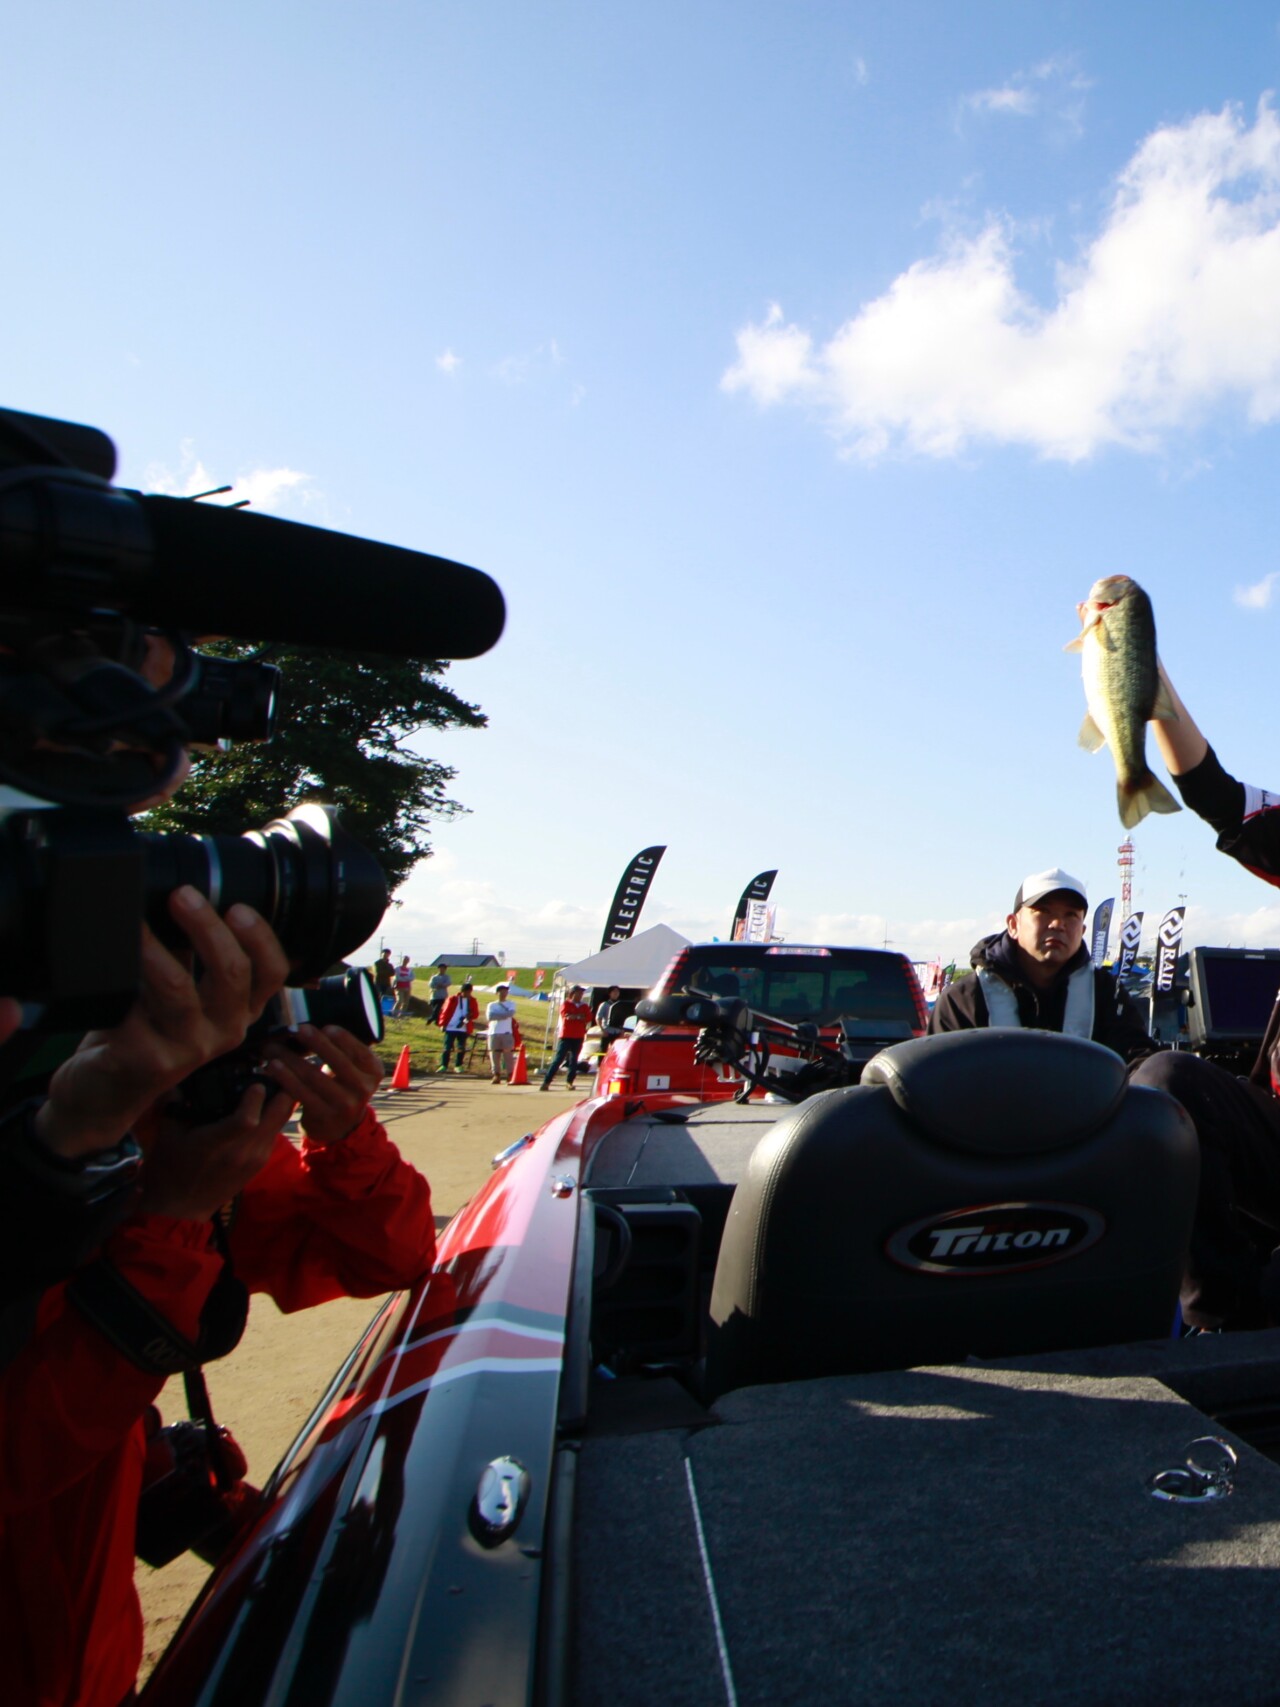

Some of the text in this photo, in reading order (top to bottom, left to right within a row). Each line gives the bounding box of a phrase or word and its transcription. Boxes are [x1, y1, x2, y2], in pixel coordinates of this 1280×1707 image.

[611, 856, 653, 942] ELECTRIC
[1162, 948, 1176, 991] RAID
[929, 1226, 1070, 1257] Triton
